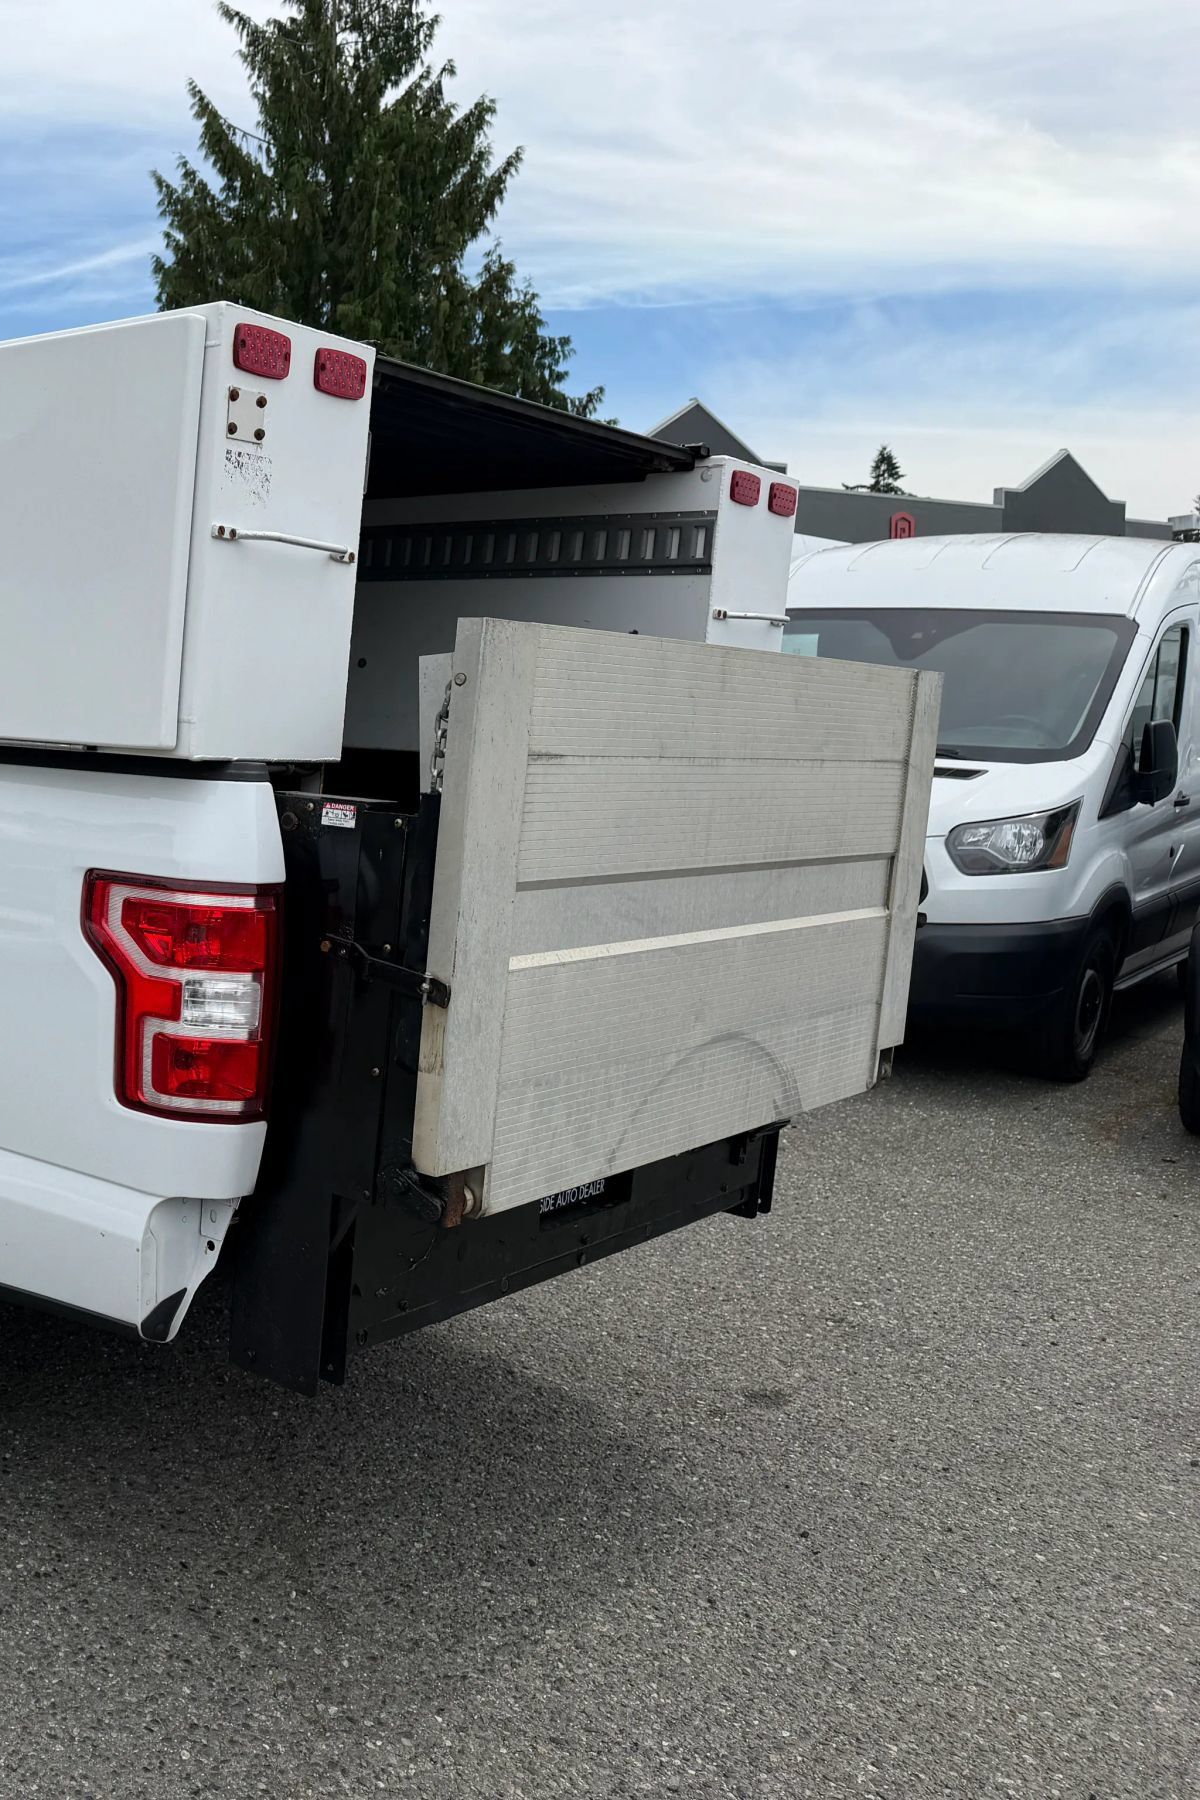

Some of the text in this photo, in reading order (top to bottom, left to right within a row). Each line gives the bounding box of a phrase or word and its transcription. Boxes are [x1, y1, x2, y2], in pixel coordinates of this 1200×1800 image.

[331, 803, 355, 811] DANGER
[555, 1188, 578, 1208] AUTO
[578, 1179, 605, 1200] DEALER
